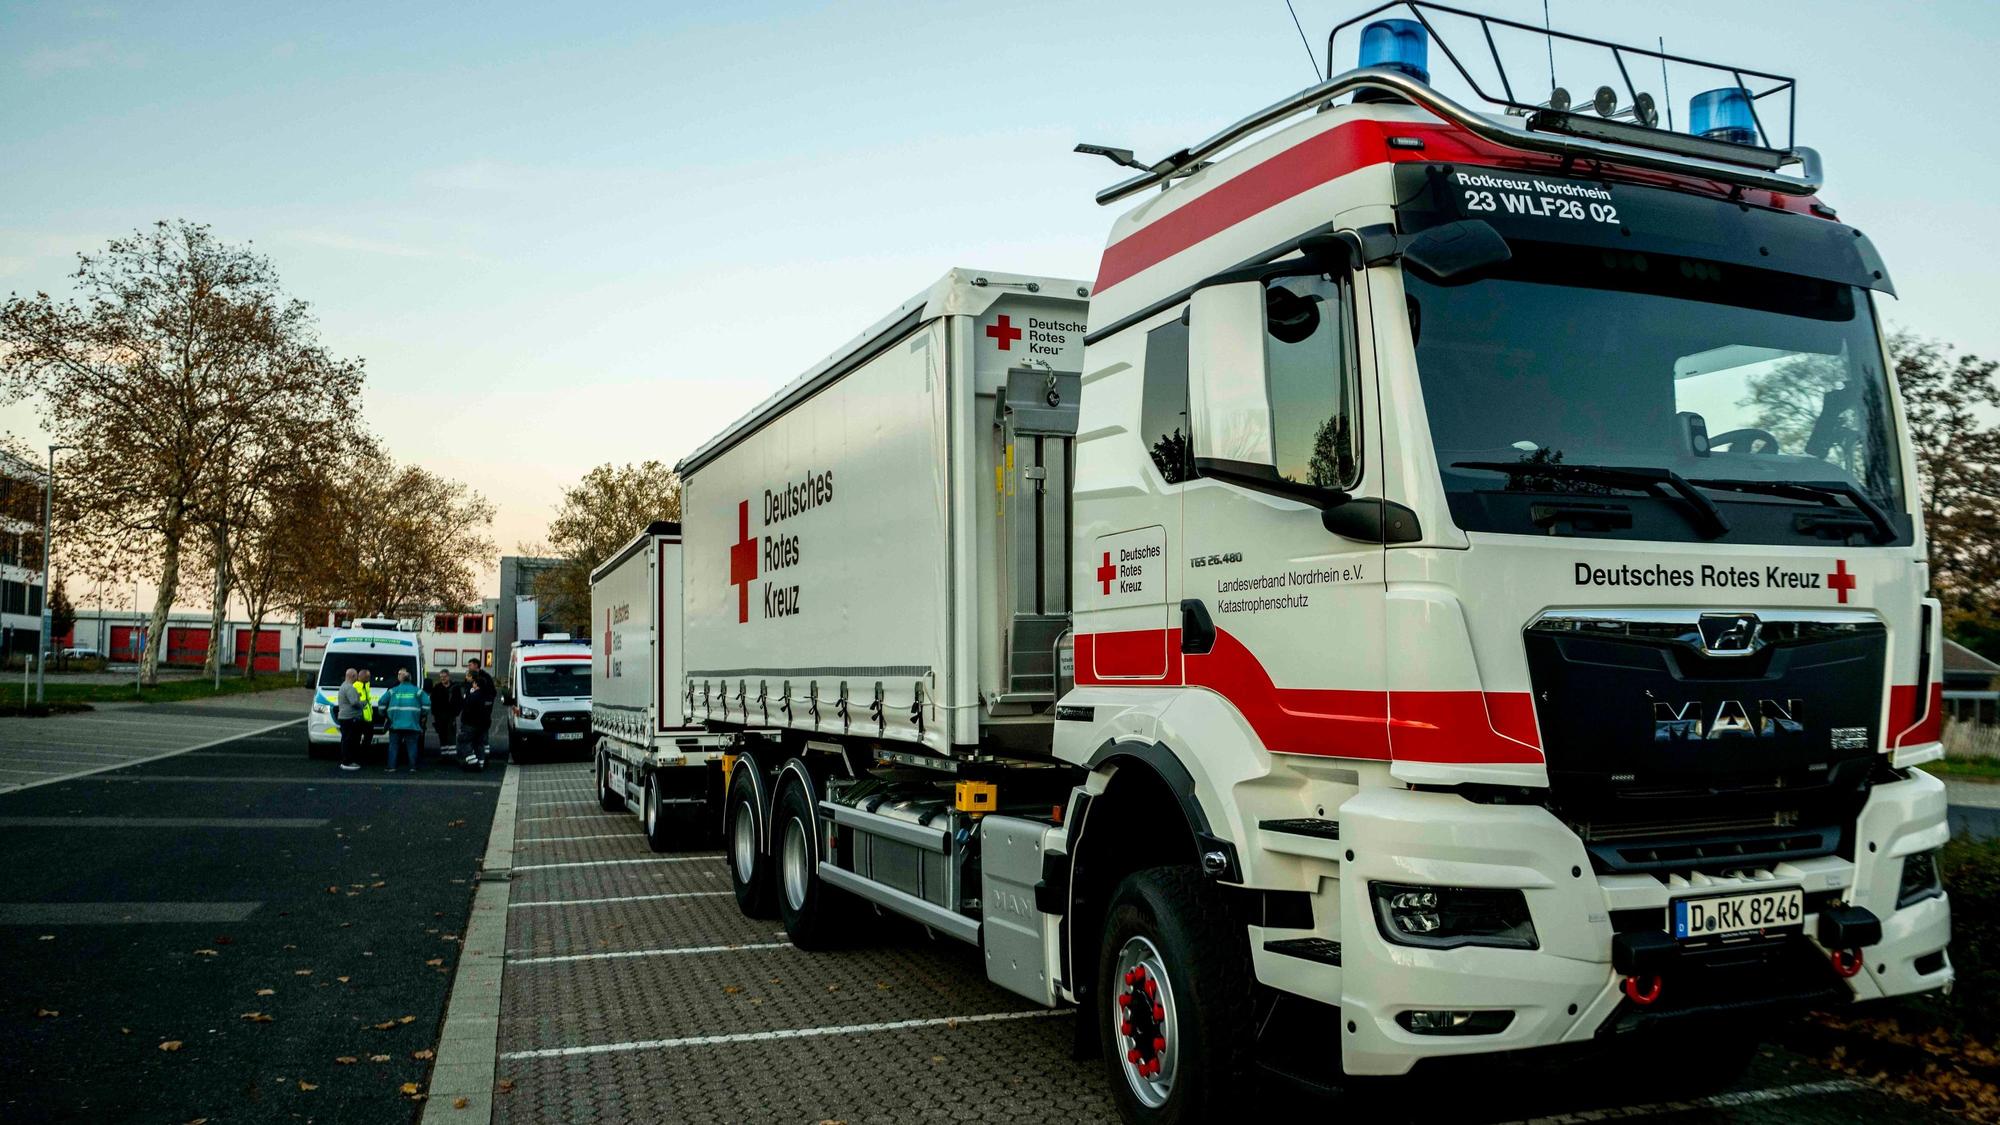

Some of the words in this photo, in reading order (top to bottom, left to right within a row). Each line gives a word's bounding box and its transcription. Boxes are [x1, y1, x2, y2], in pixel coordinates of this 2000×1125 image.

[1456, 172, 1532, 191] Rotkreuz
[1533, 180, 1611, 200] Nordrhein
[1464, 190, 1497, 212] 23
[1499, 193, 1585, 220] WLF26
[1589, 203, 1620, 224] 02
[1029, 330, 1065, 343] Rotes
[1029, 342, 1064, 355] Kreu
[764, 470, 833, 526] Deutsches
[764, 533, 799, 572] Rotes
[1120, 545, 1160, 561] Deutsches
[1120, 564, 1142, 577] Rotes
[1217, 573, 1286, 593] Landesverband
[1288, 567, 1339, 586] Nordrhein
[1342, 564, 1363, 581] e.V.
[1575, 562, 1694, 586] Deutsches
[1701, 565, 1760, 587] Rotes
[1766, 566, 1821, 588] Kreuz
[764, 581, 799, 618] Kreuz
[1120, 580, 1142, 593] Kreuz
[1217, 594, 1308, 614] Katastrophenschutz
[1653, 699, 1803, 741] MAN
[992, 889, 1033, 919] MAN
[1691, 904, 1704, 932] D
[1718, 900, 1744, 929] RK
[1750, 894, 1800, 926] 8246
